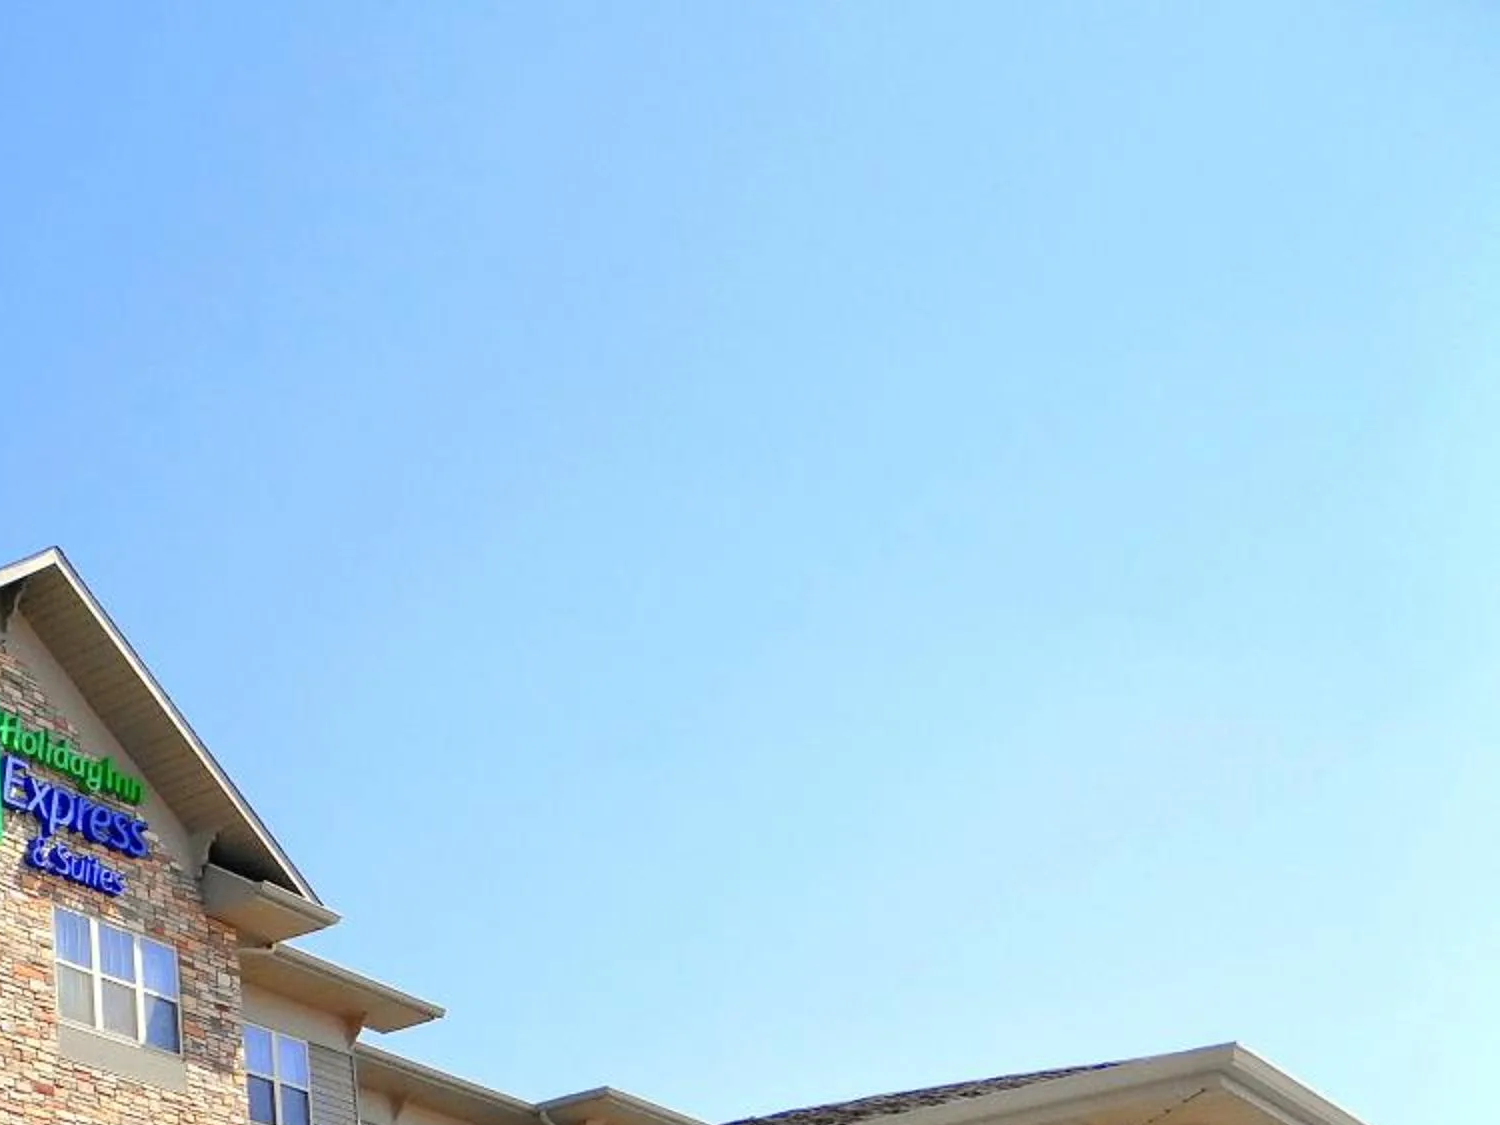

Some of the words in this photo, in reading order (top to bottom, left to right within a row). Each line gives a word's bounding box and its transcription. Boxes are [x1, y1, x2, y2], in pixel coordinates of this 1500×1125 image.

[0, 711, 102, 792] Holiday
[102, 758, 143, 804] Inn
[2, 754, 149, 857] Express
[51, 842, 125, 897] Suites
